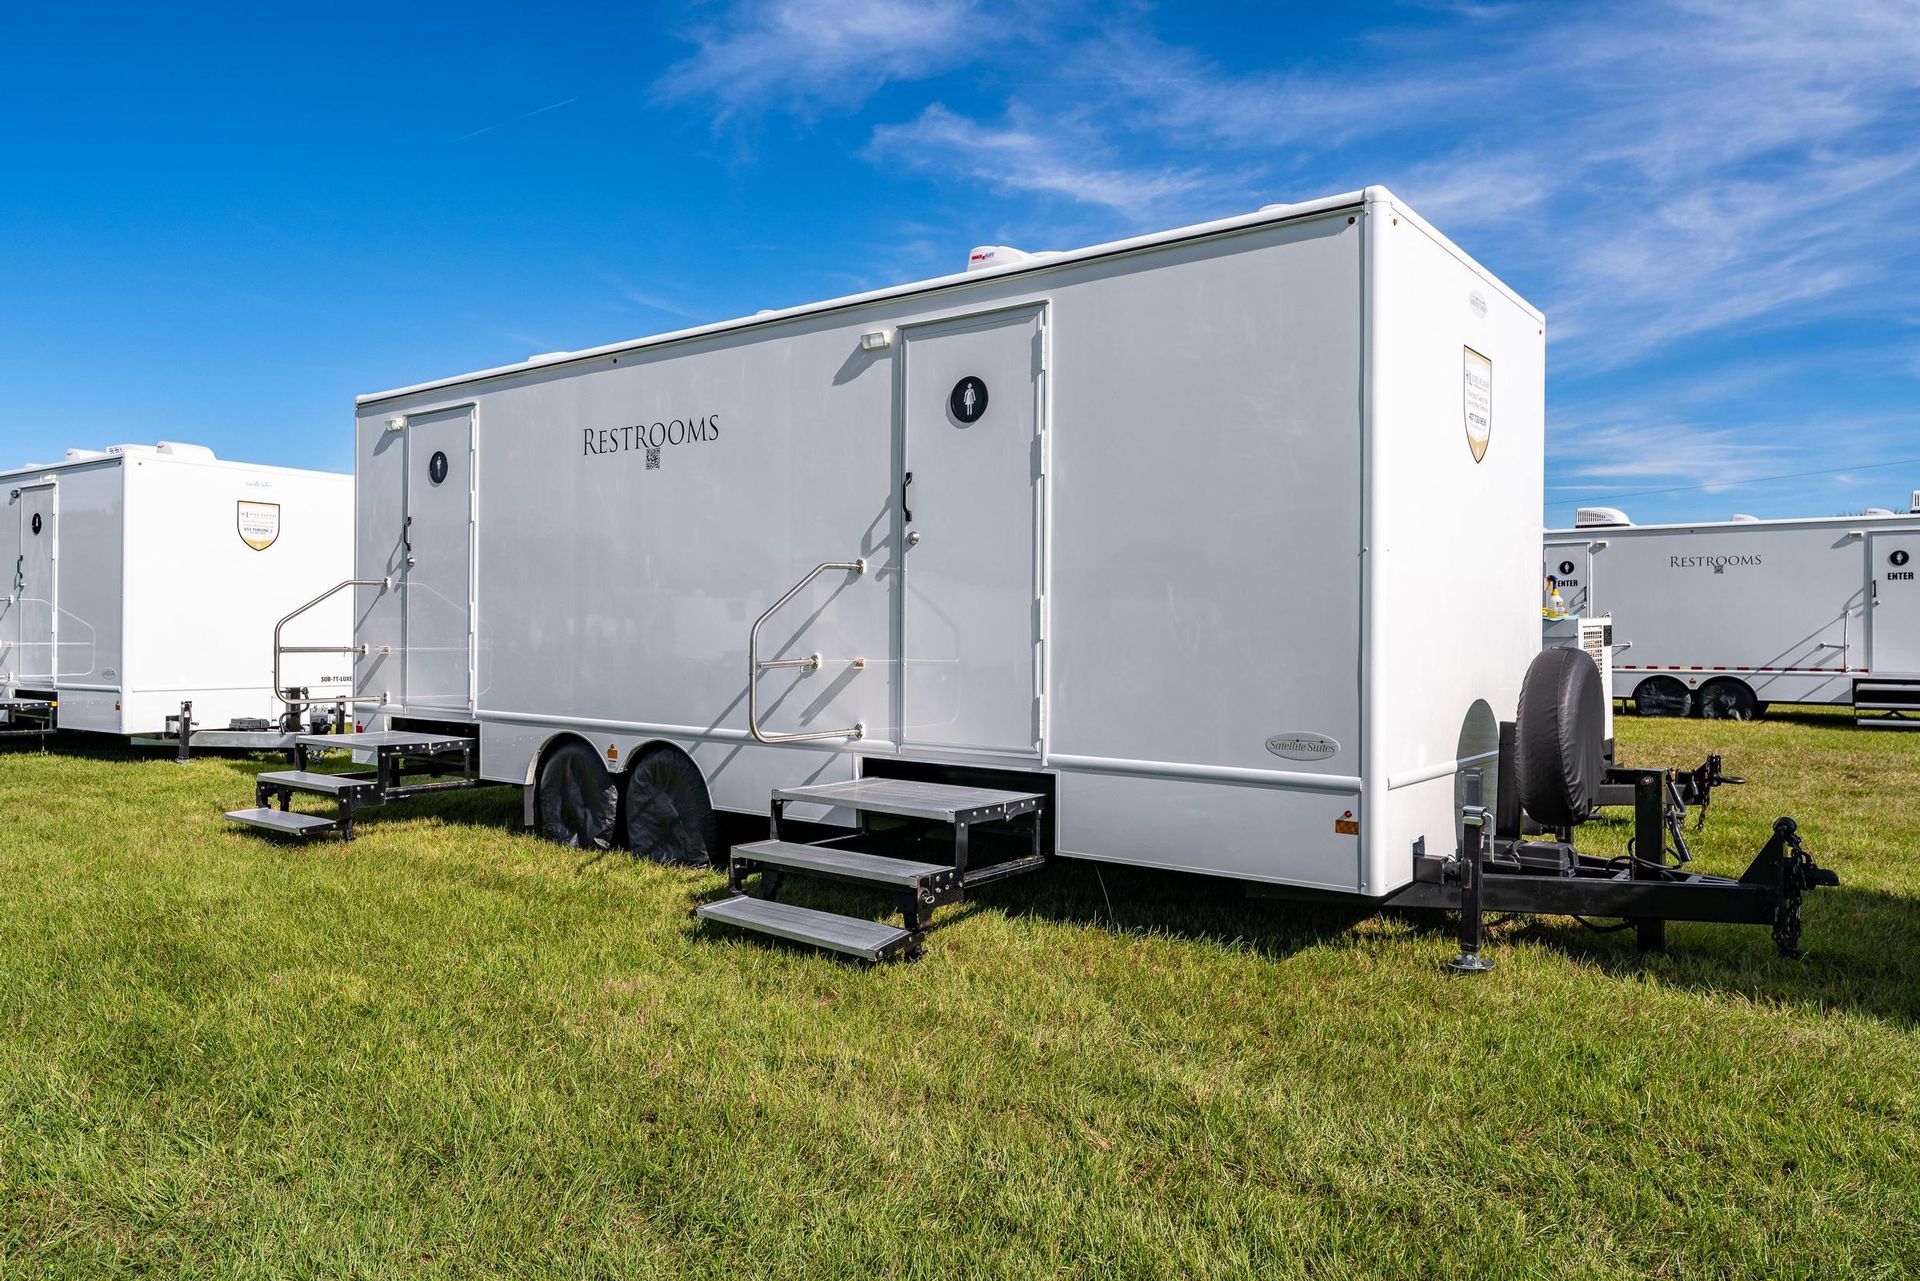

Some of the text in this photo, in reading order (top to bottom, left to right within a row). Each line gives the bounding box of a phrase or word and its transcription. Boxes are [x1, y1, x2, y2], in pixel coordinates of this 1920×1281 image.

[1887, 572, 1914, 581] ENTER
[1557, 579, 1579, 588] ENTER
[1269, 740, 1336, 754] Satellite Suites
